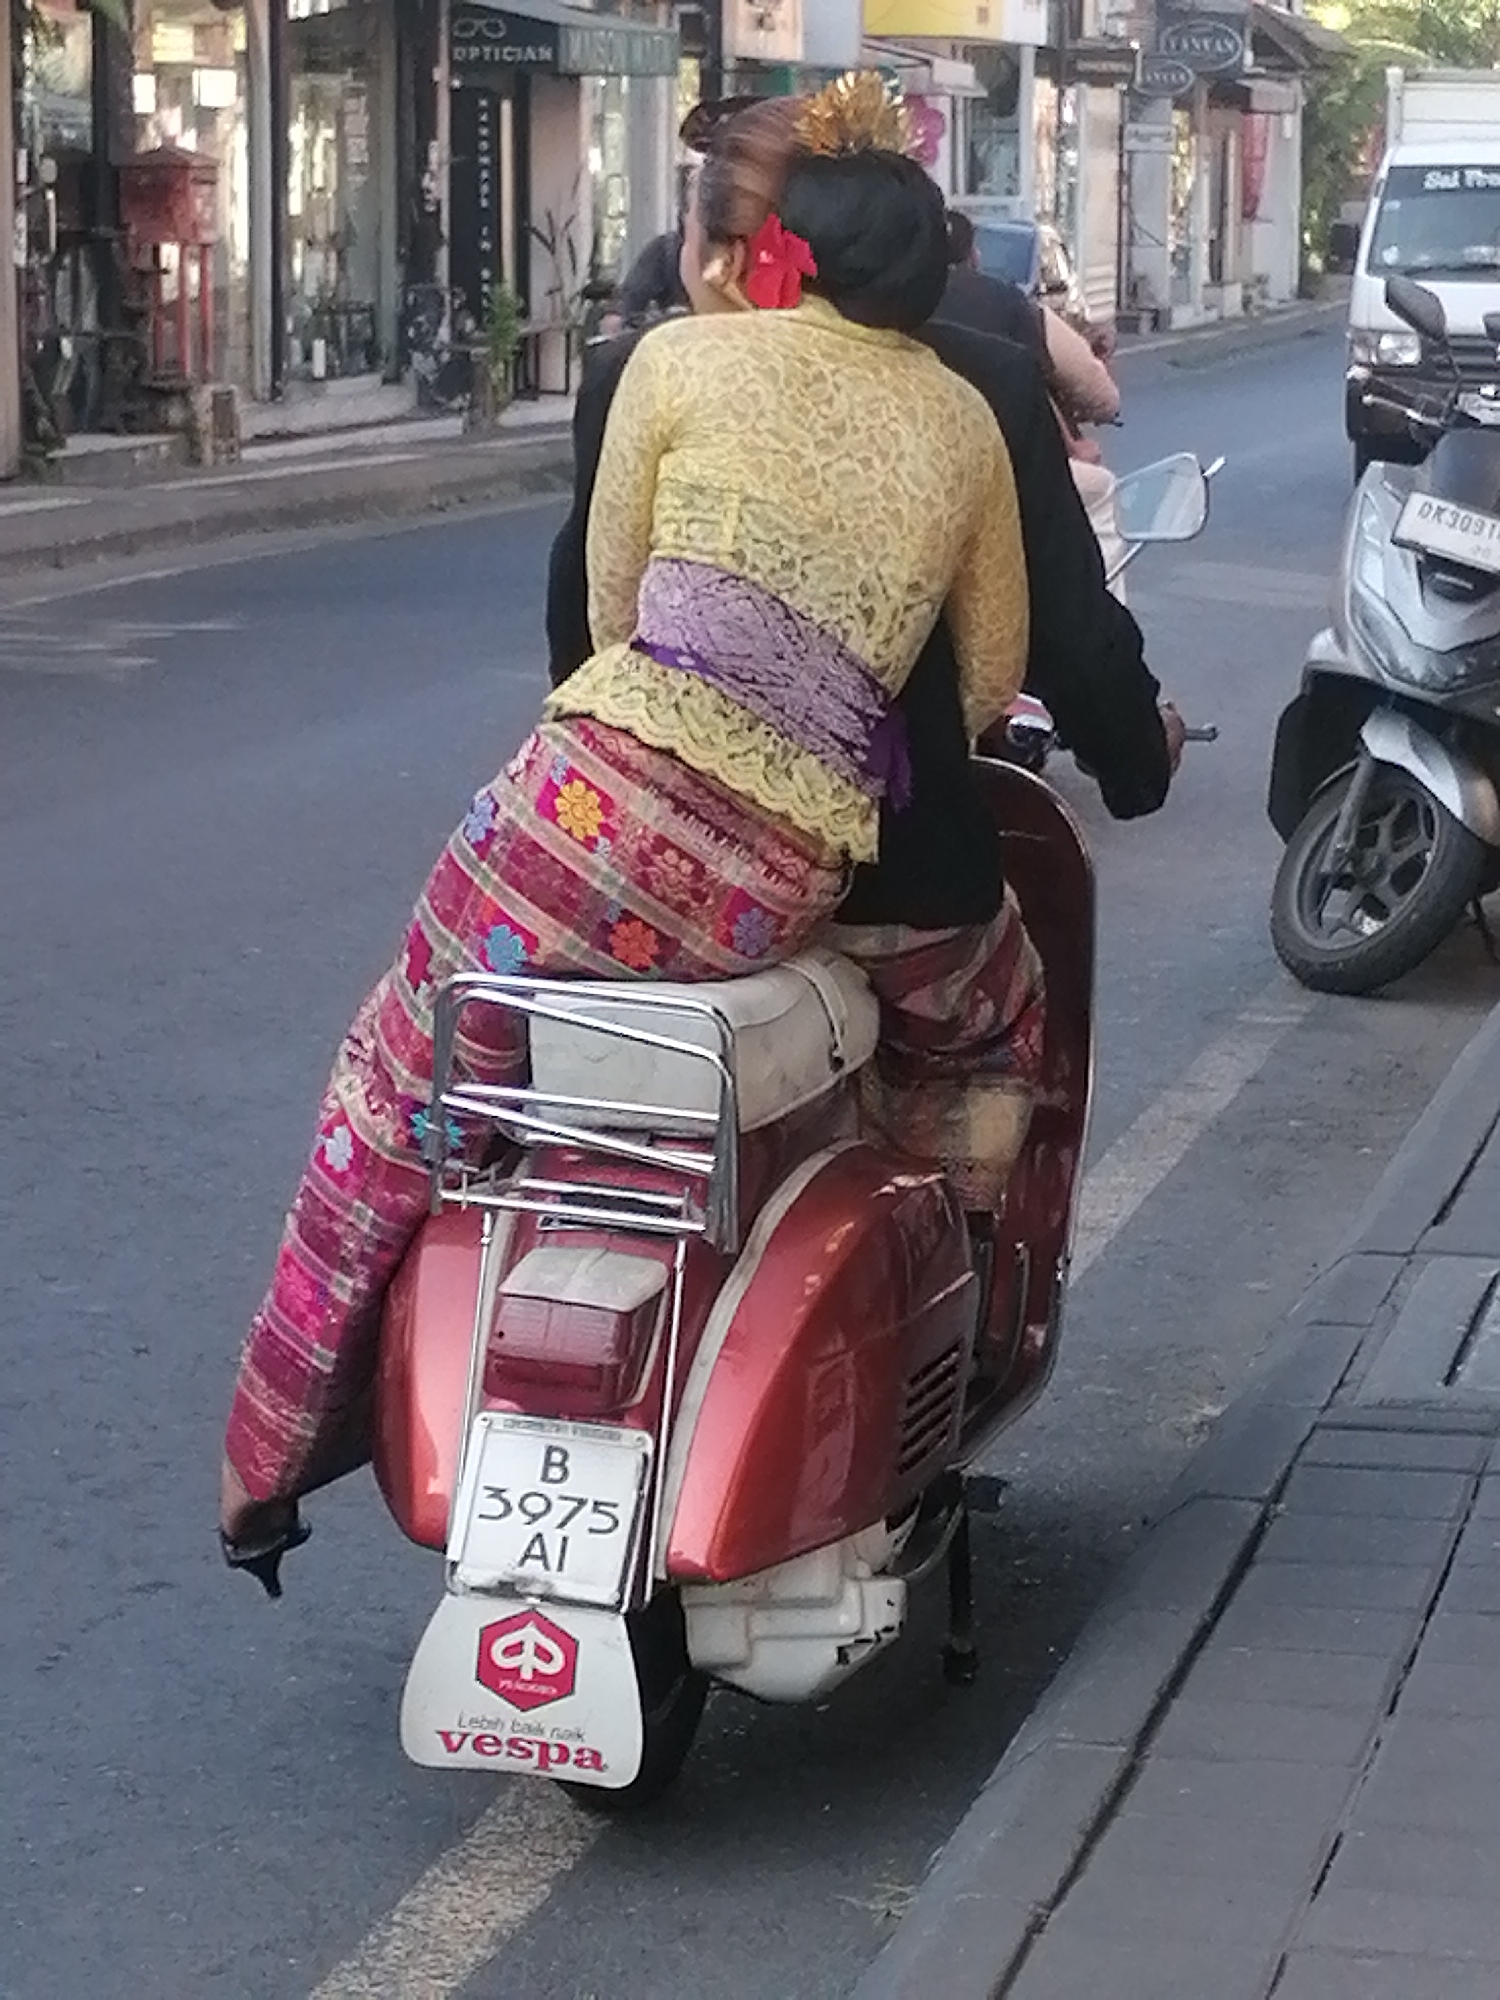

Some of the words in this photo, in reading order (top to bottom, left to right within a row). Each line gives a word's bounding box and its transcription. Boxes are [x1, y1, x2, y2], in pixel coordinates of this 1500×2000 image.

[453, 46, 553, 62] OPTICIAN
[540, 1445, 570, 1484] B
[478, 1485, 619, 1535] 3975
[517, 1532, 569, 1572] AI
[457, 1710, 504, 1732] Lebih
[436, 1730, 606, 1773] vespa
